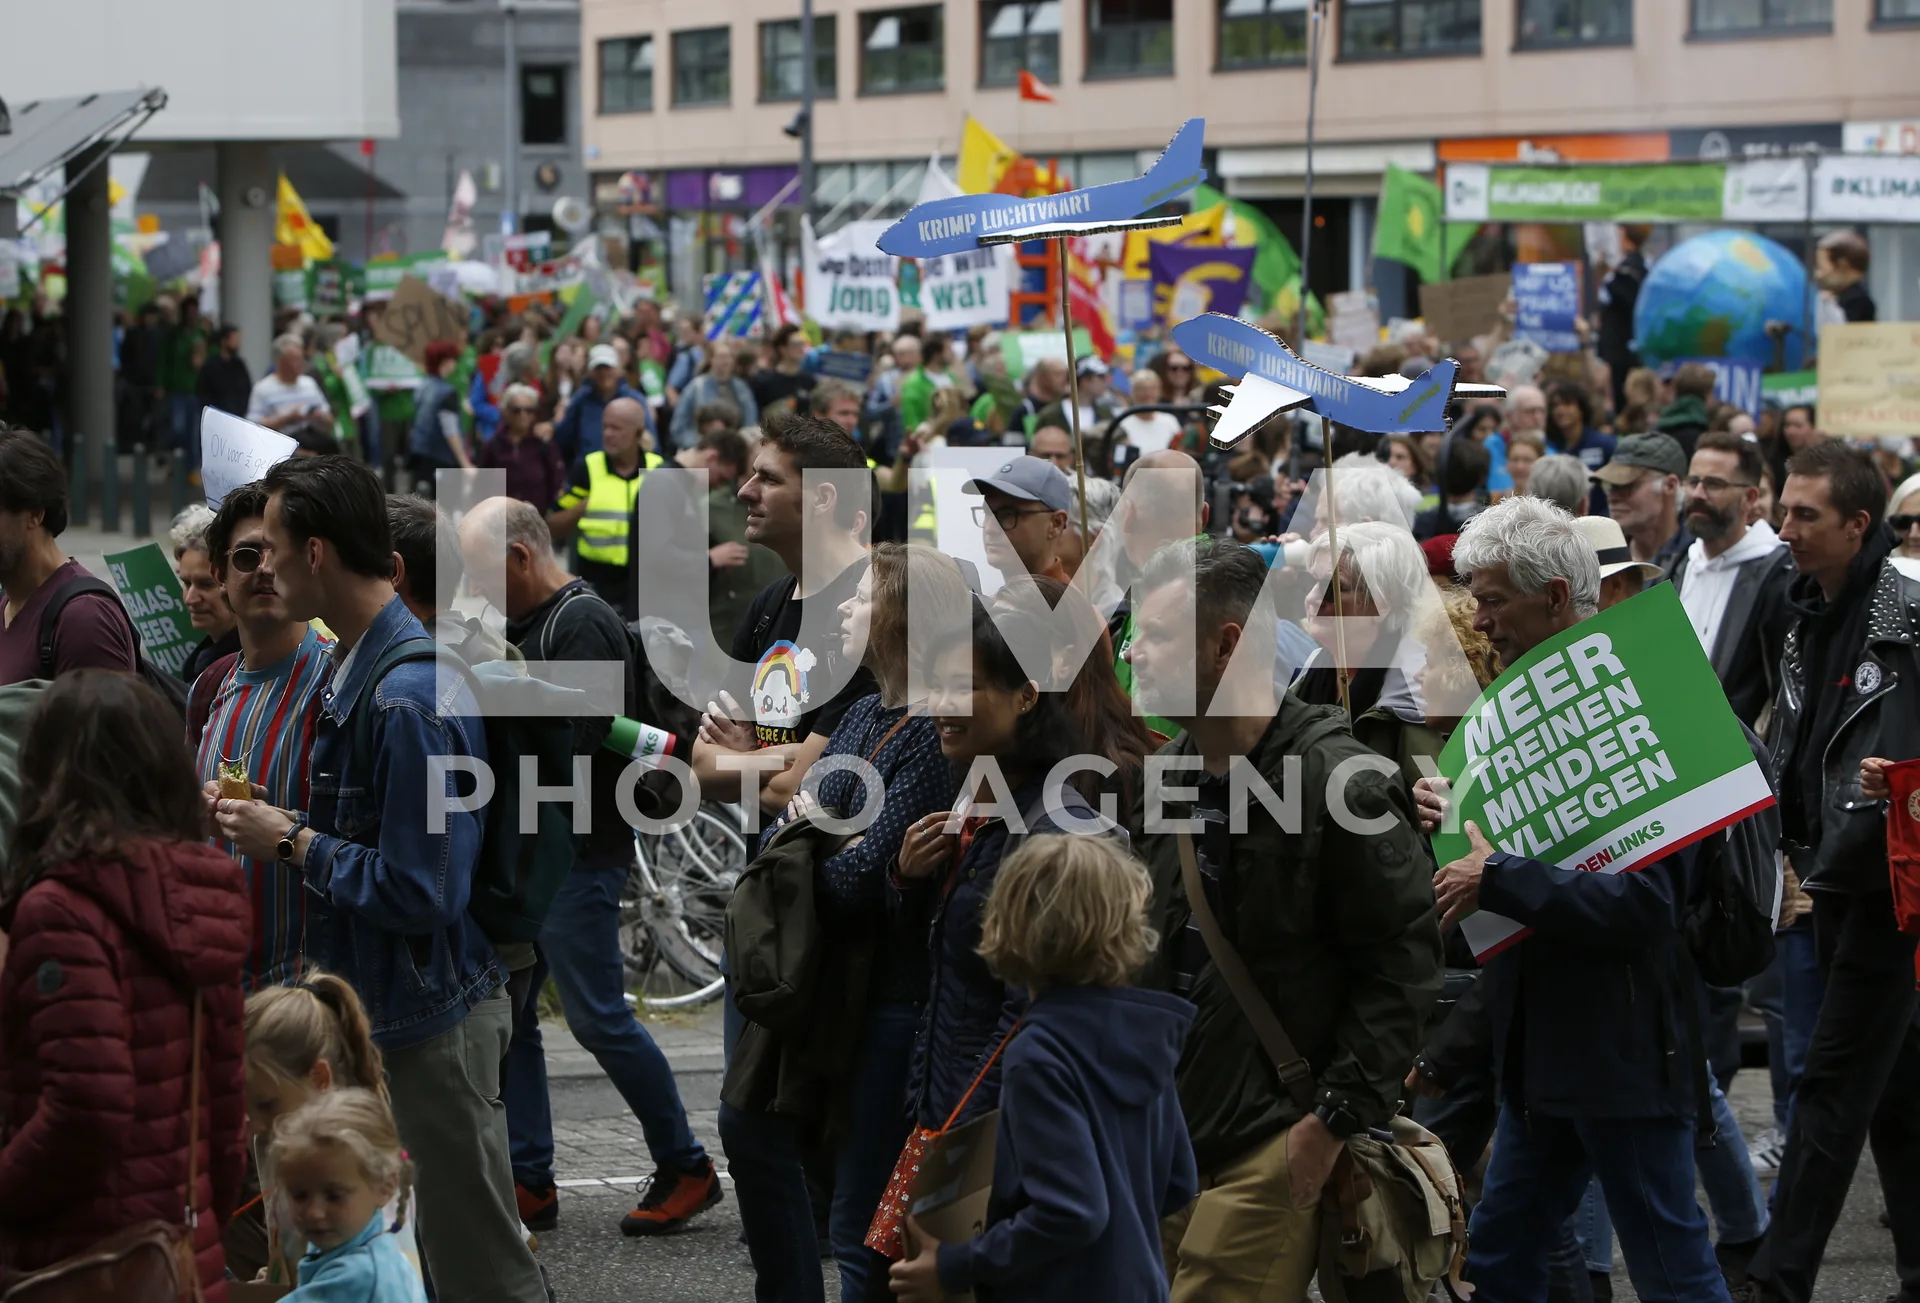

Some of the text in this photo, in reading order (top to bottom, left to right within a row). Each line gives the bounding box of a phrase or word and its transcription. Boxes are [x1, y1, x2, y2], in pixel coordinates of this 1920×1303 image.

[918, 193, 1092, 243] KRIMP LUCHTVAART
[828, 273, 891, 317] jong
[931, 275, 988, 311] wat
[1208, 332, 1256, 366] KRIMP
[1260, 352, 1350, 405] LUCHTVAART
[211, 434, 228, 458] OV
[249, 458, 273, 479] gel
[110, 562, 131, 588] EY
[122, 585, 184, 618] BAAS,
[140, 616, 182, 648] EER
[1464, 632, 1626, 764] MEER
[1471, 676, 1643, 795] TREINEN
[1482, 715, 1660, 836] MINDER
[1498, 750, 1678, 857] VLIEGEN
